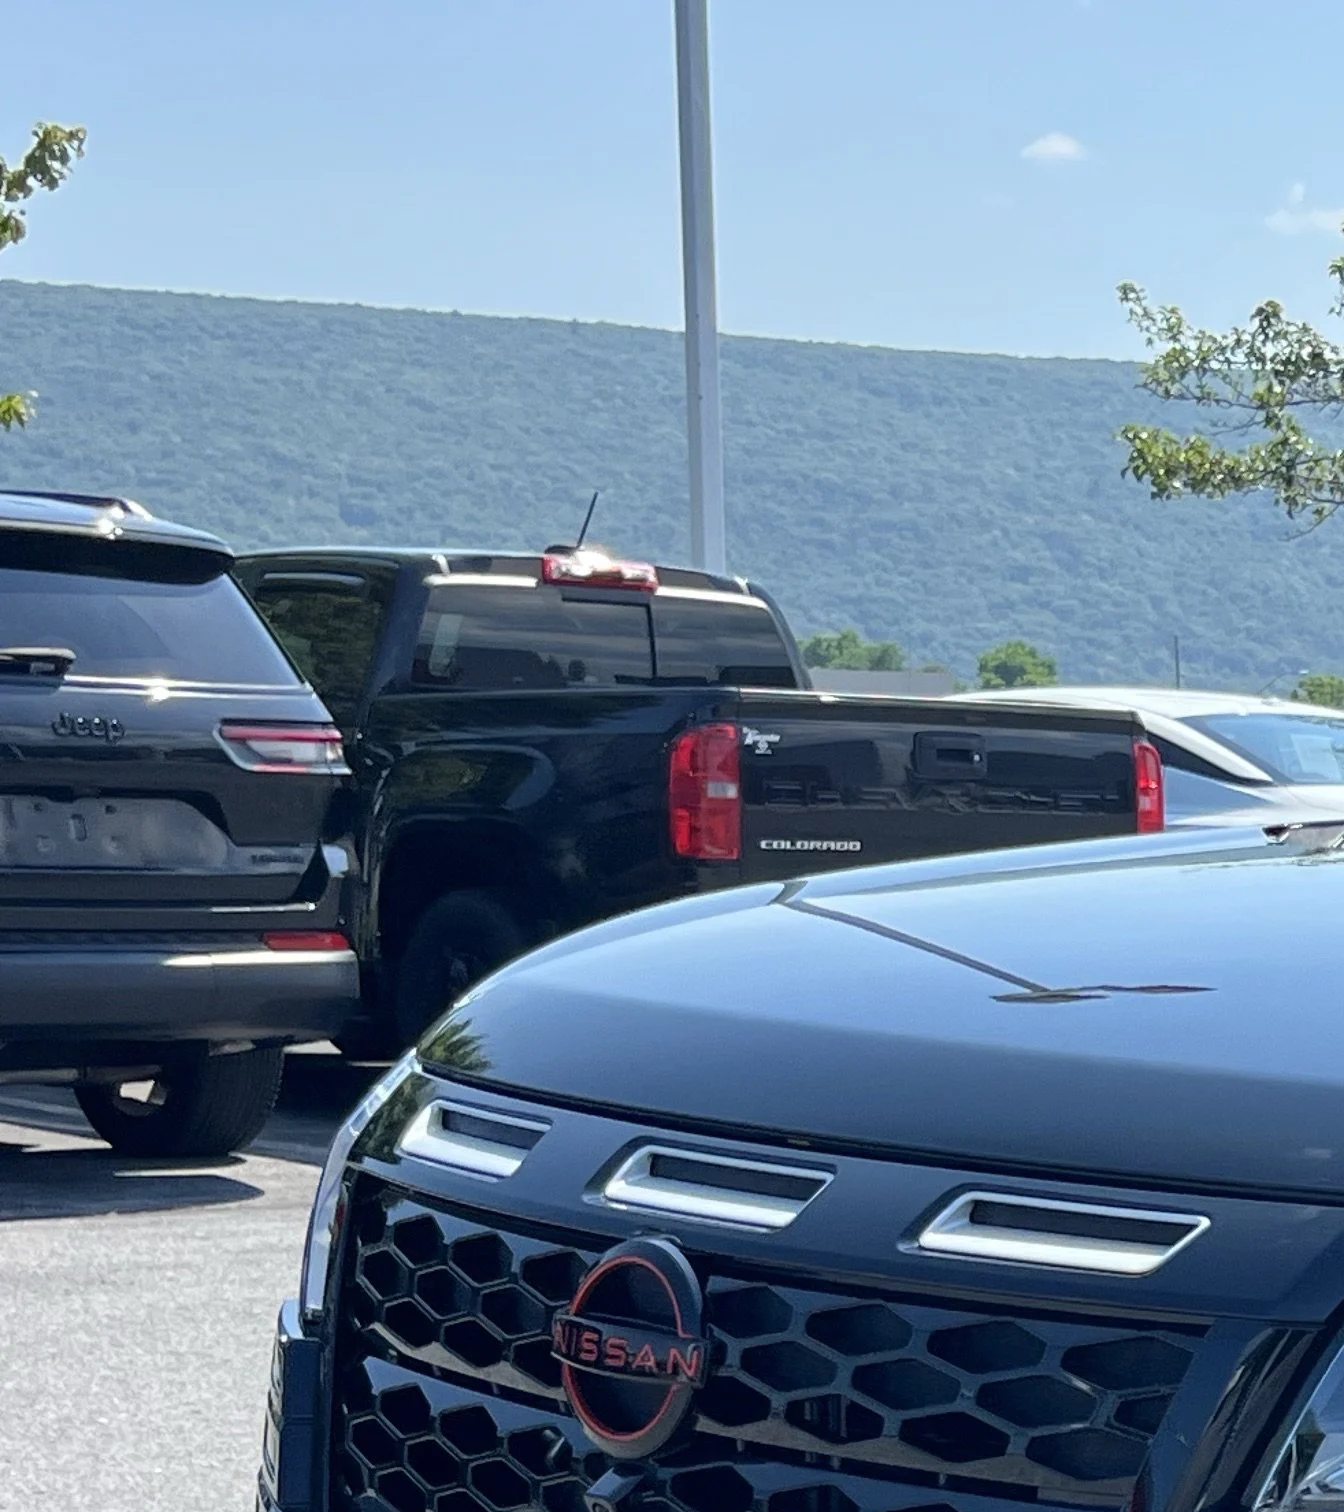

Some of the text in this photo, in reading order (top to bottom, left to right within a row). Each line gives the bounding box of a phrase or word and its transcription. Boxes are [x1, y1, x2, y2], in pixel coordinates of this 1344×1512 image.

[51, 712, 124, 745] Jeep
[760, 840, 862, 851] COLORADO
[553, 1320, 701, 1378] NISSAN
